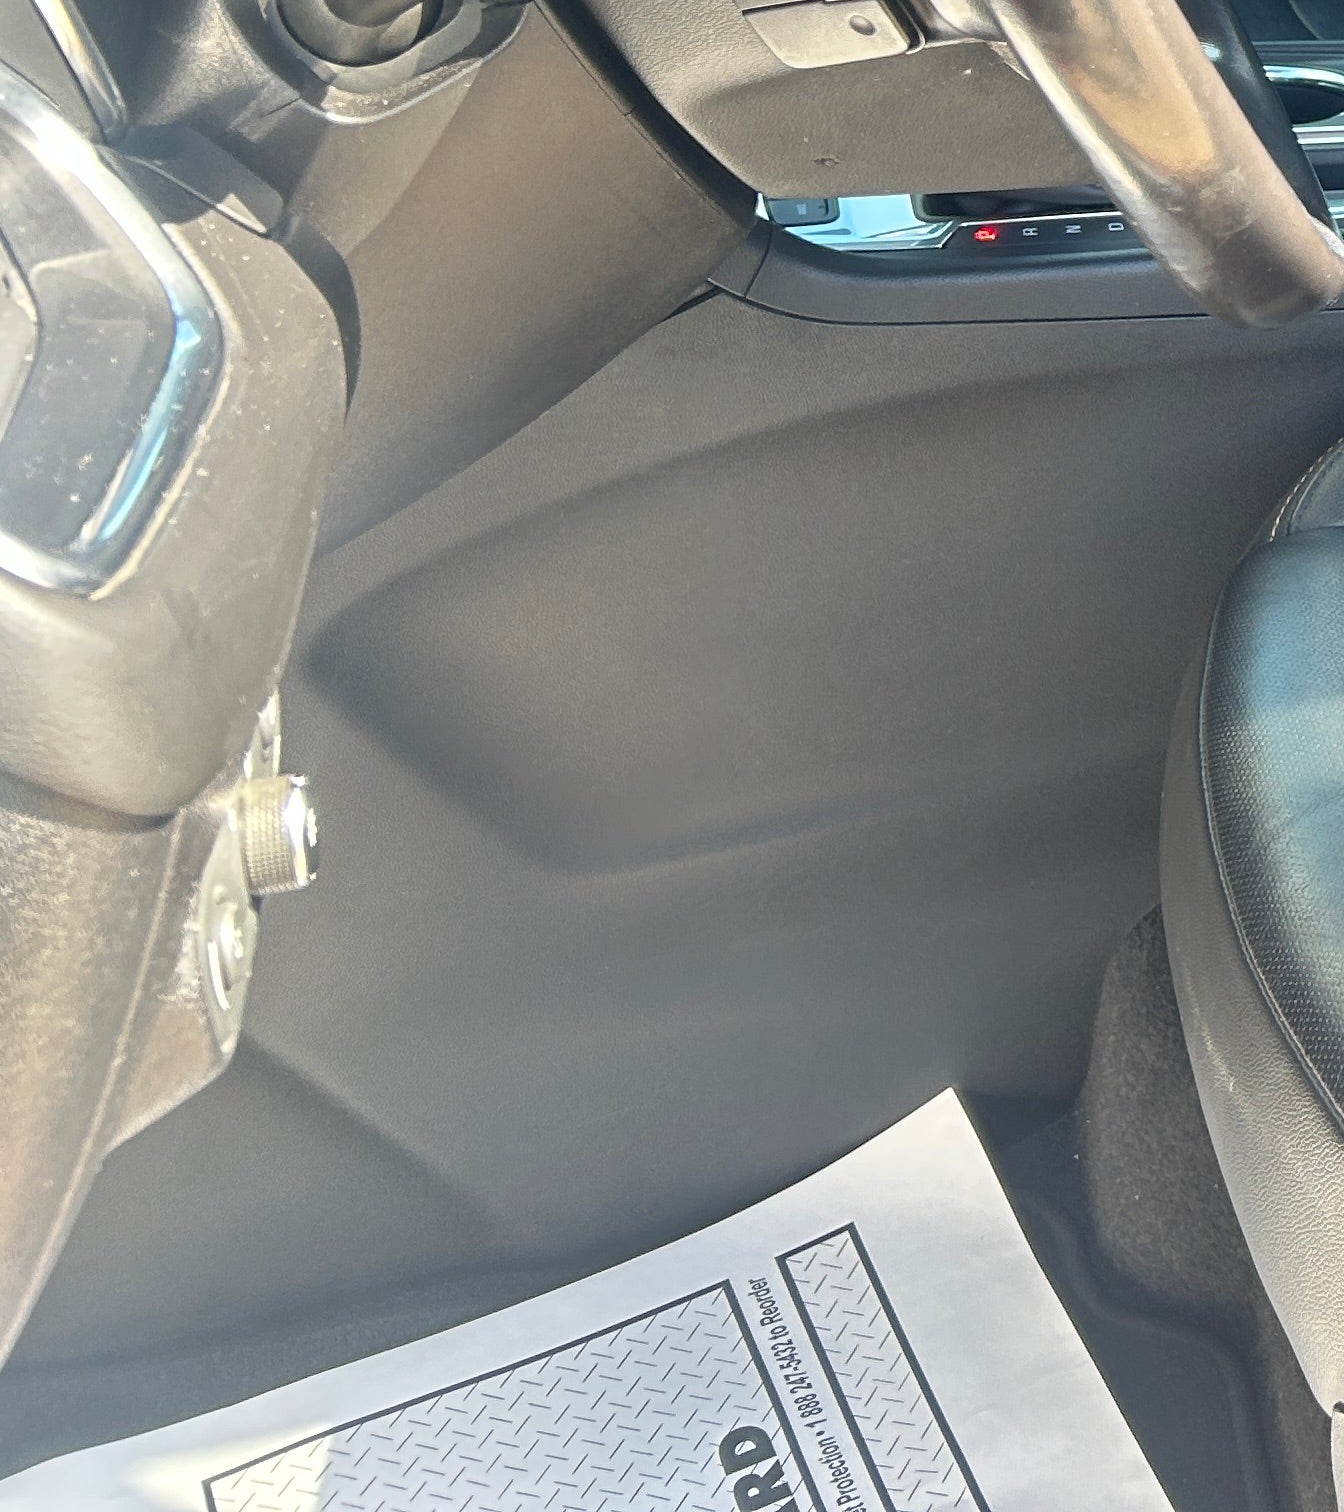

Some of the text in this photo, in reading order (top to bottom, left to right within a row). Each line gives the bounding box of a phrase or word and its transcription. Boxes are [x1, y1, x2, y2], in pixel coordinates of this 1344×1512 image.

[1022, 227, 1039, 237] R
[1065, 224, 1082, 234] N
[747, 1277, 783, 1328] Reorder
[768, 1321, 789, 1341] to
[771, 1339, 814, 1394] 247-5432
[794, 1393, 824, 1419] 888
[719, 1426, 800, 1512] RD
[817, 1435, 861, 1507] Protection
